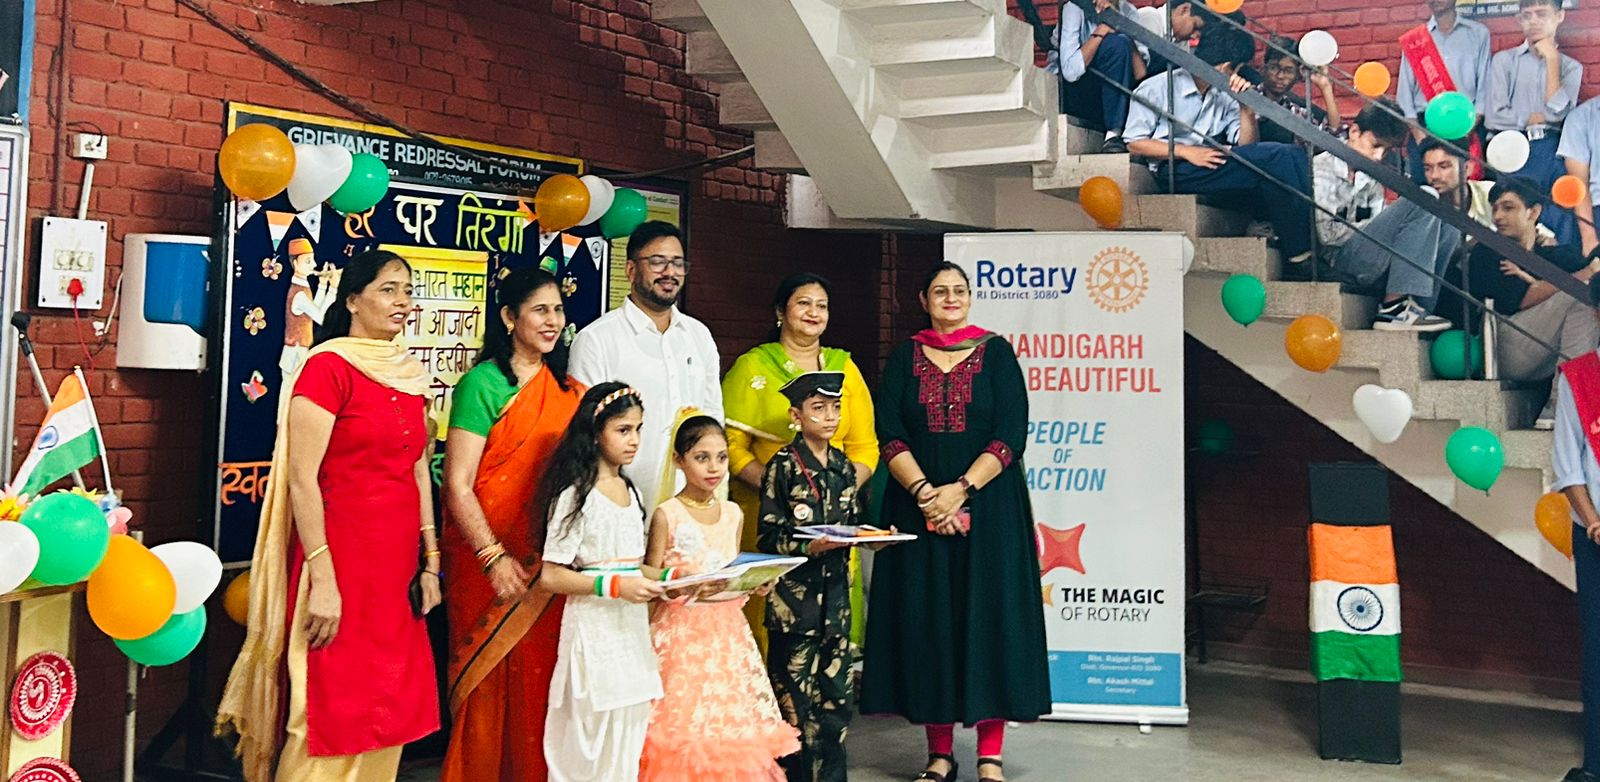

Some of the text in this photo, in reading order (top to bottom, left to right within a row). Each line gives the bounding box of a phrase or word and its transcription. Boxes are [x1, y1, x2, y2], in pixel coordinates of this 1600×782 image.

[287, 126, 541, 182] GRIEVANCE REDRESSAL FORUM
[393, 194, 444, 246] घर
[456, 192, 530, 254] तिरंगा
[976, 260, 1077, 294] Rotary
[976, 290, 1059, 300] RI District 3080
[1009, 333, 1143, 359] ANDIGARH
[1028, 367, 1161, 393] BEAUTIFUL
[1053, 448, 1073, 464] OF
[1026, 467, 1106, 492] ACTION
[1061, 587, 1165, 604] THE MAGIC
[1060, 606, 1151, 622] OF ROTARY
